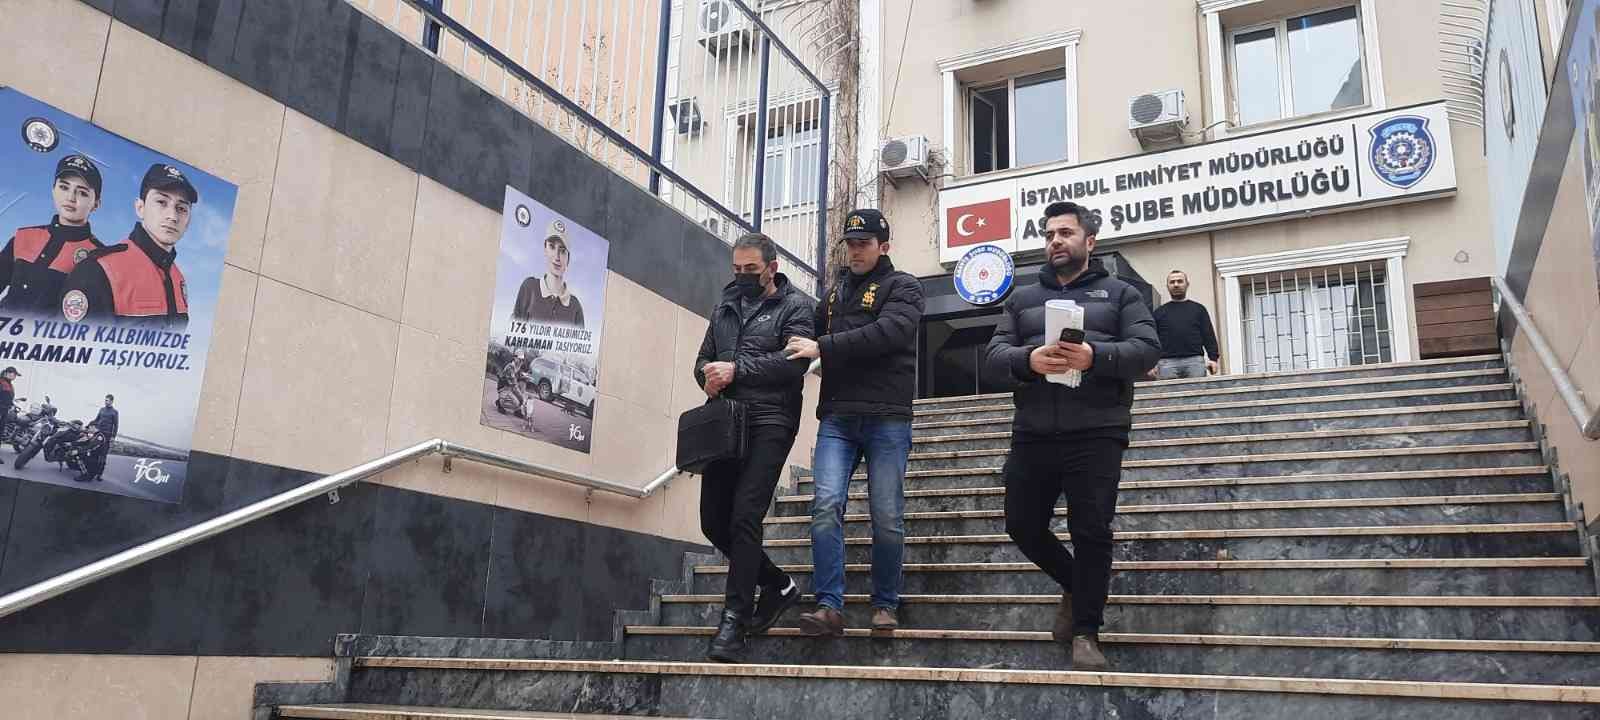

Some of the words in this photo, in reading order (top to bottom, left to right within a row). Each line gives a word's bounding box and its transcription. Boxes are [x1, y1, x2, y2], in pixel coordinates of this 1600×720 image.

[1020, 178, 1110, 207] İSTANBUL
[1115, 161, 1202, 191] EMNİYET
[1209, 134, 1344, 176] MÜDÜRLÜĞÜ
[1110, 197, 1174, 231] ŞUBE
[1182, 165, 1350, 216] MÜDÜRLÜĞÜ
[32, 319, 90, 343] YILDIR
[93, 325, 191, 349] KALBİMİZDE
[510, 321, 527, 334] 176
[529, 324, 551, 337] YILDIR
[504, 335, 553, 350] KAHRAMAN
[98, 348, 190, 371] TAŞIYORUZ.
